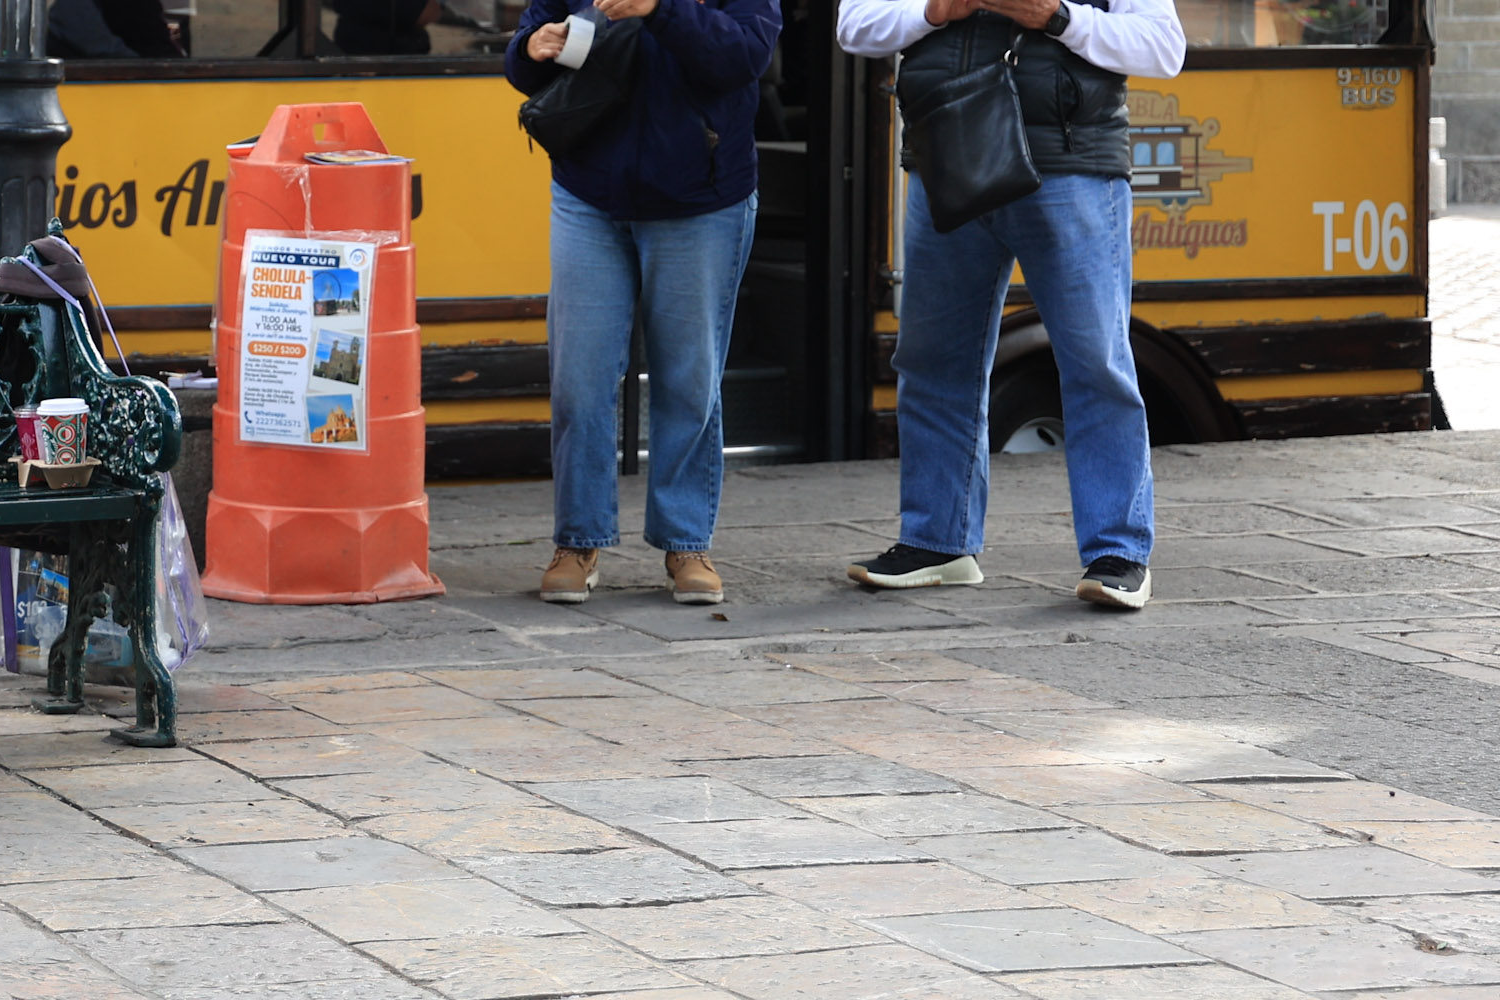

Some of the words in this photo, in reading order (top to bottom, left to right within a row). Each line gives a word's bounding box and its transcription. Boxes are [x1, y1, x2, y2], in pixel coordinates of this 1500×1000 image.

[1337, 67, 1401, 85] 9-160
[1342, 87, 1396, 105] BUS
[1132, 213, 1248, 260] Antiguos
[1312, 199, 1409, 272] T-06
[252, 253, 296, 263] NUEVO
[301, 255, 337, 266] TOUR
[251, 283, 302, 300] SENDELA
[261, 315, 281, 323] 11:00
